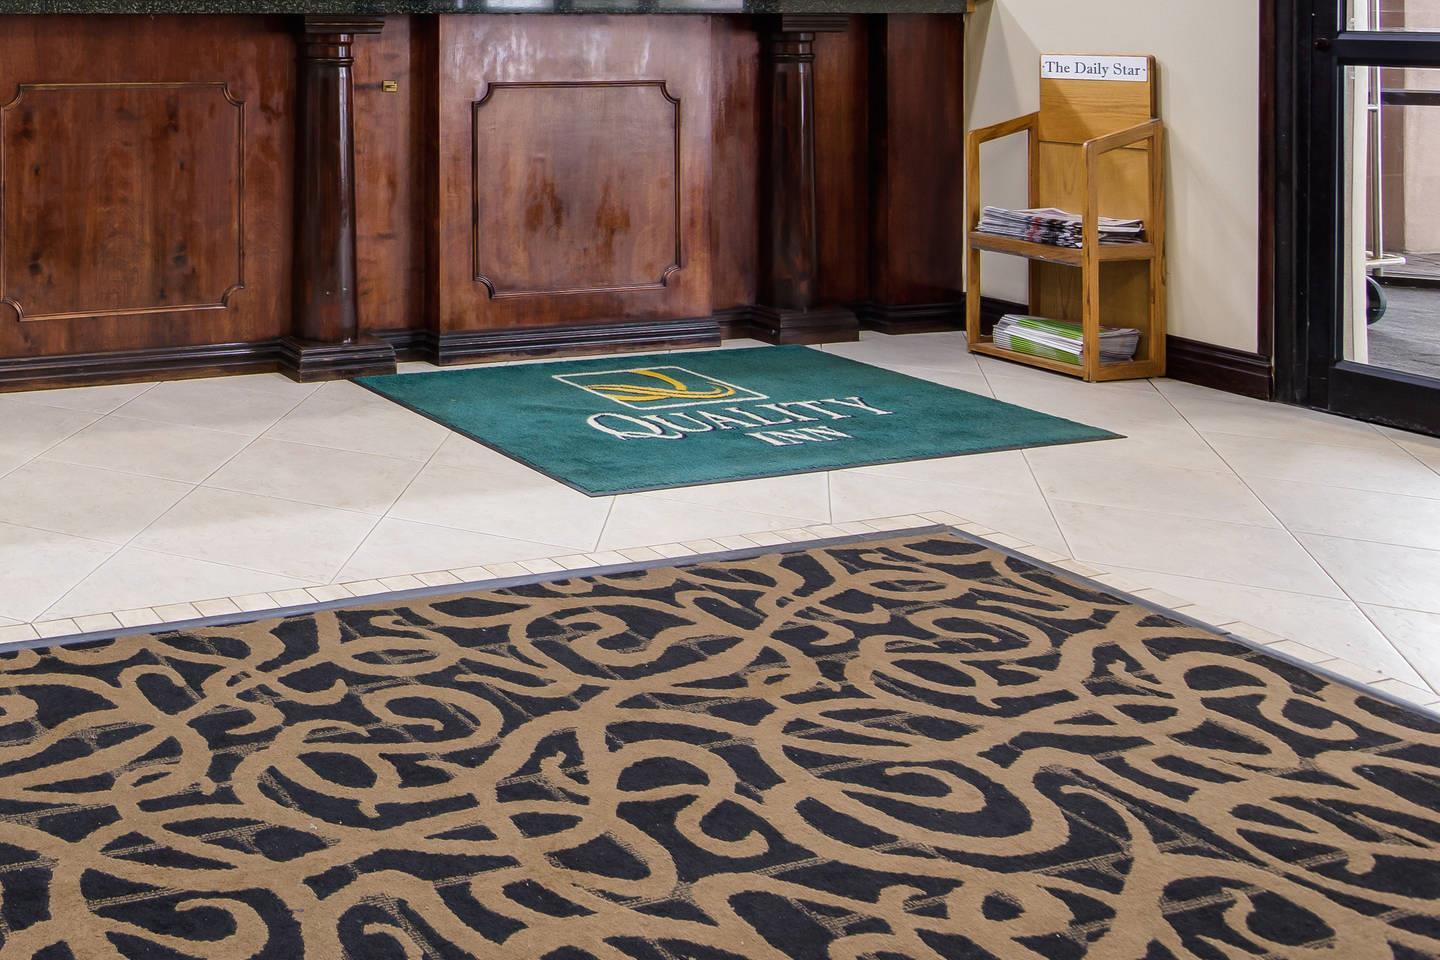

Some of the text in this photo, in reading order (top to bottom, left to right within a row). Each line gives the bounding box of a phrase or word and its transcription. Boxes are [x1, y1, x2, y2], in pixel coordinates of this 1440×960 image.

[1045, 61, 1141, 78] The Daily Star
[586, 396, 895, 441] QUALITY
[744, 425, 854, 447] INN
